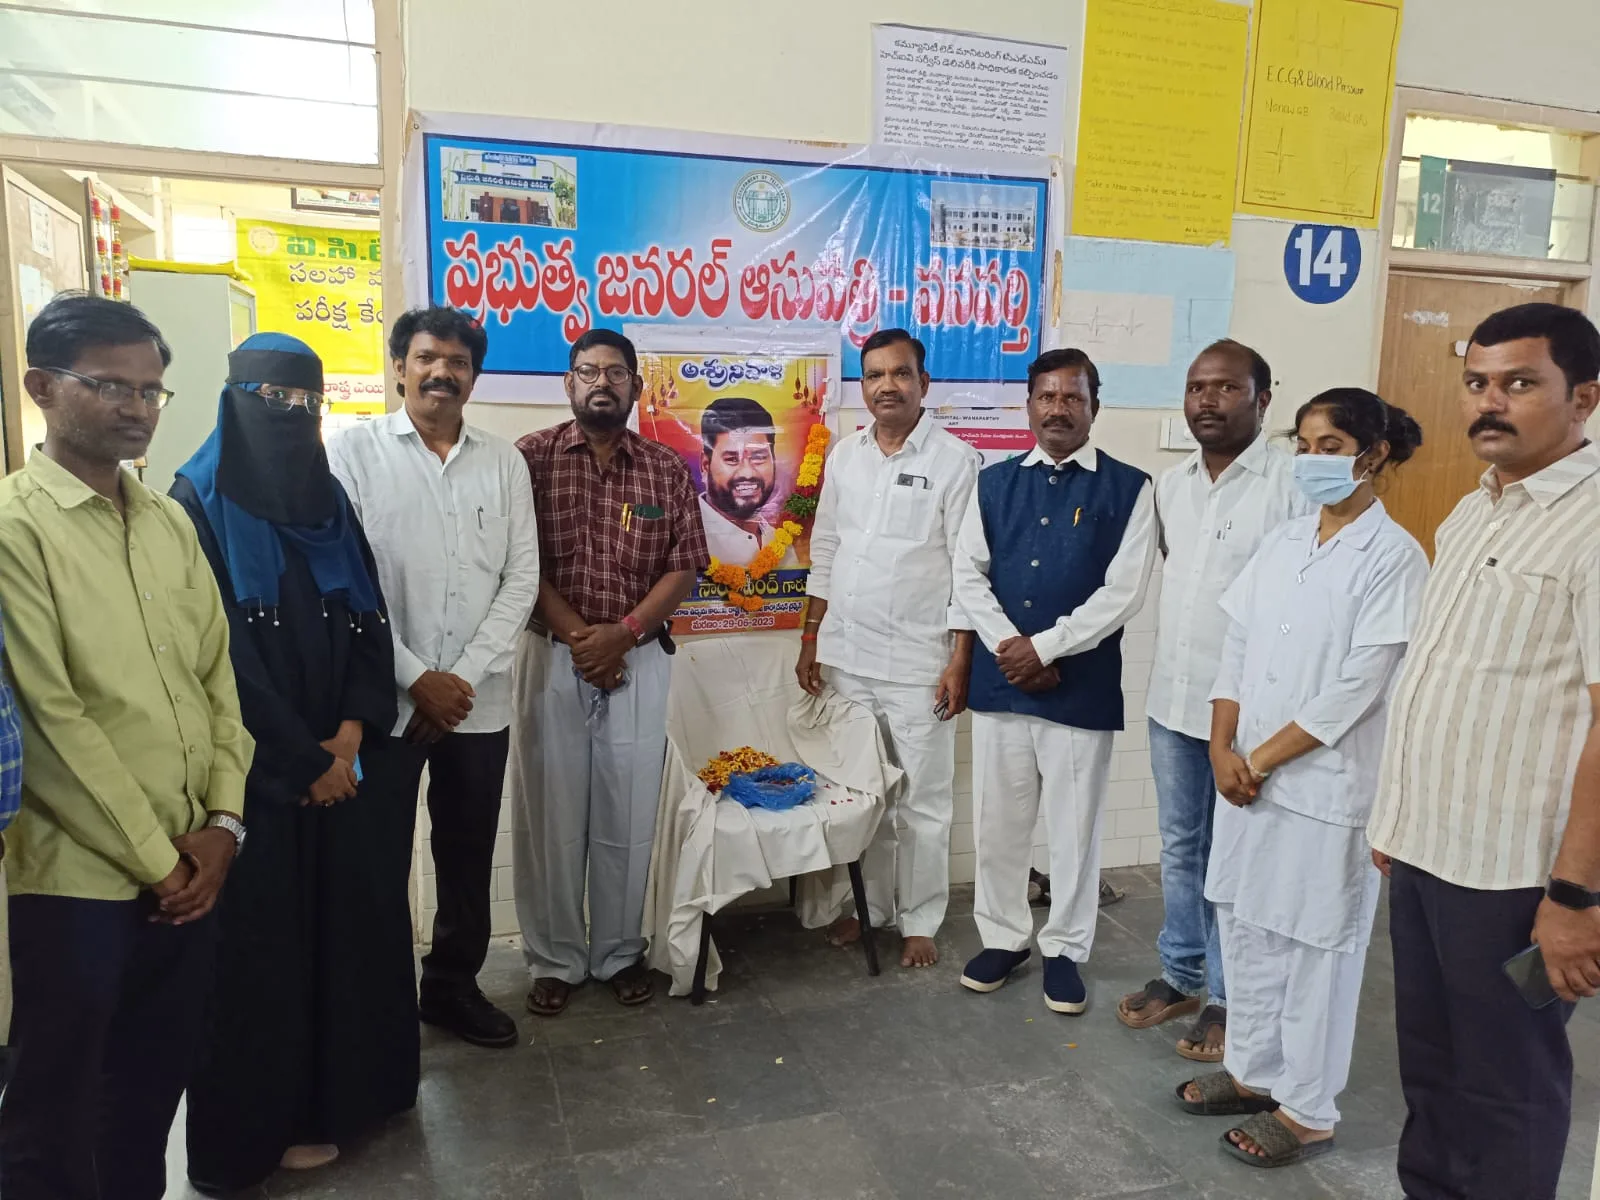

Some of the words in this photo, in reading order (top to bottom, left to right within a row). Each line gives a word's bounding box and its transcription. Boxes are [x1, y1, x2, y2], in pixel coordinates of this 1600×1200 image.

[1421, 191, 1441, 214] 12
[1295, 229, 1347, 287] 14
[289, 262, 355, 285] సలహా
[445, 232, 591, 343] ప్రభుత్వ
[598, 239, 732, 318] జనరల్
[740, 251, 878, 348] ఆసుపత్రి
[296, 296, 351, 331] పరీక్ష
[723, 617, 774, 629] 29-06-2023
